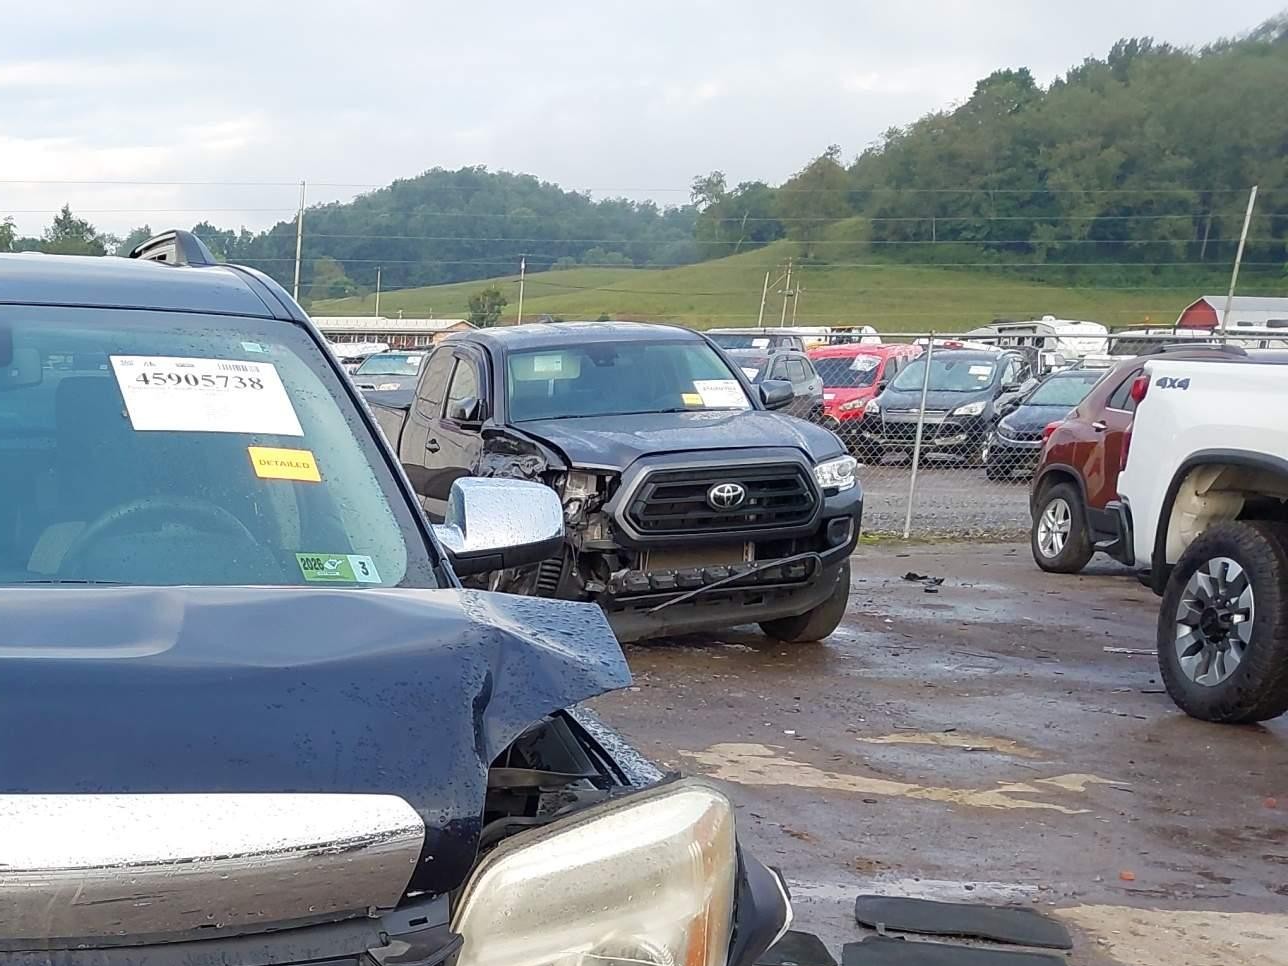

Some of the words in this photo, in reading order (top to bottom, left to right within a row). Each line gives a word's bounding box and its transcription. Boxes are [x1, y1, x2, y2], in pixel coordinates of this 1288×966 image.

[135, 372, 264, 391] 45905738
[258, 459, 311, 470] DETAILED
[300, 557, 325, 571] 2026
[358, 561, 370, 576] 3
